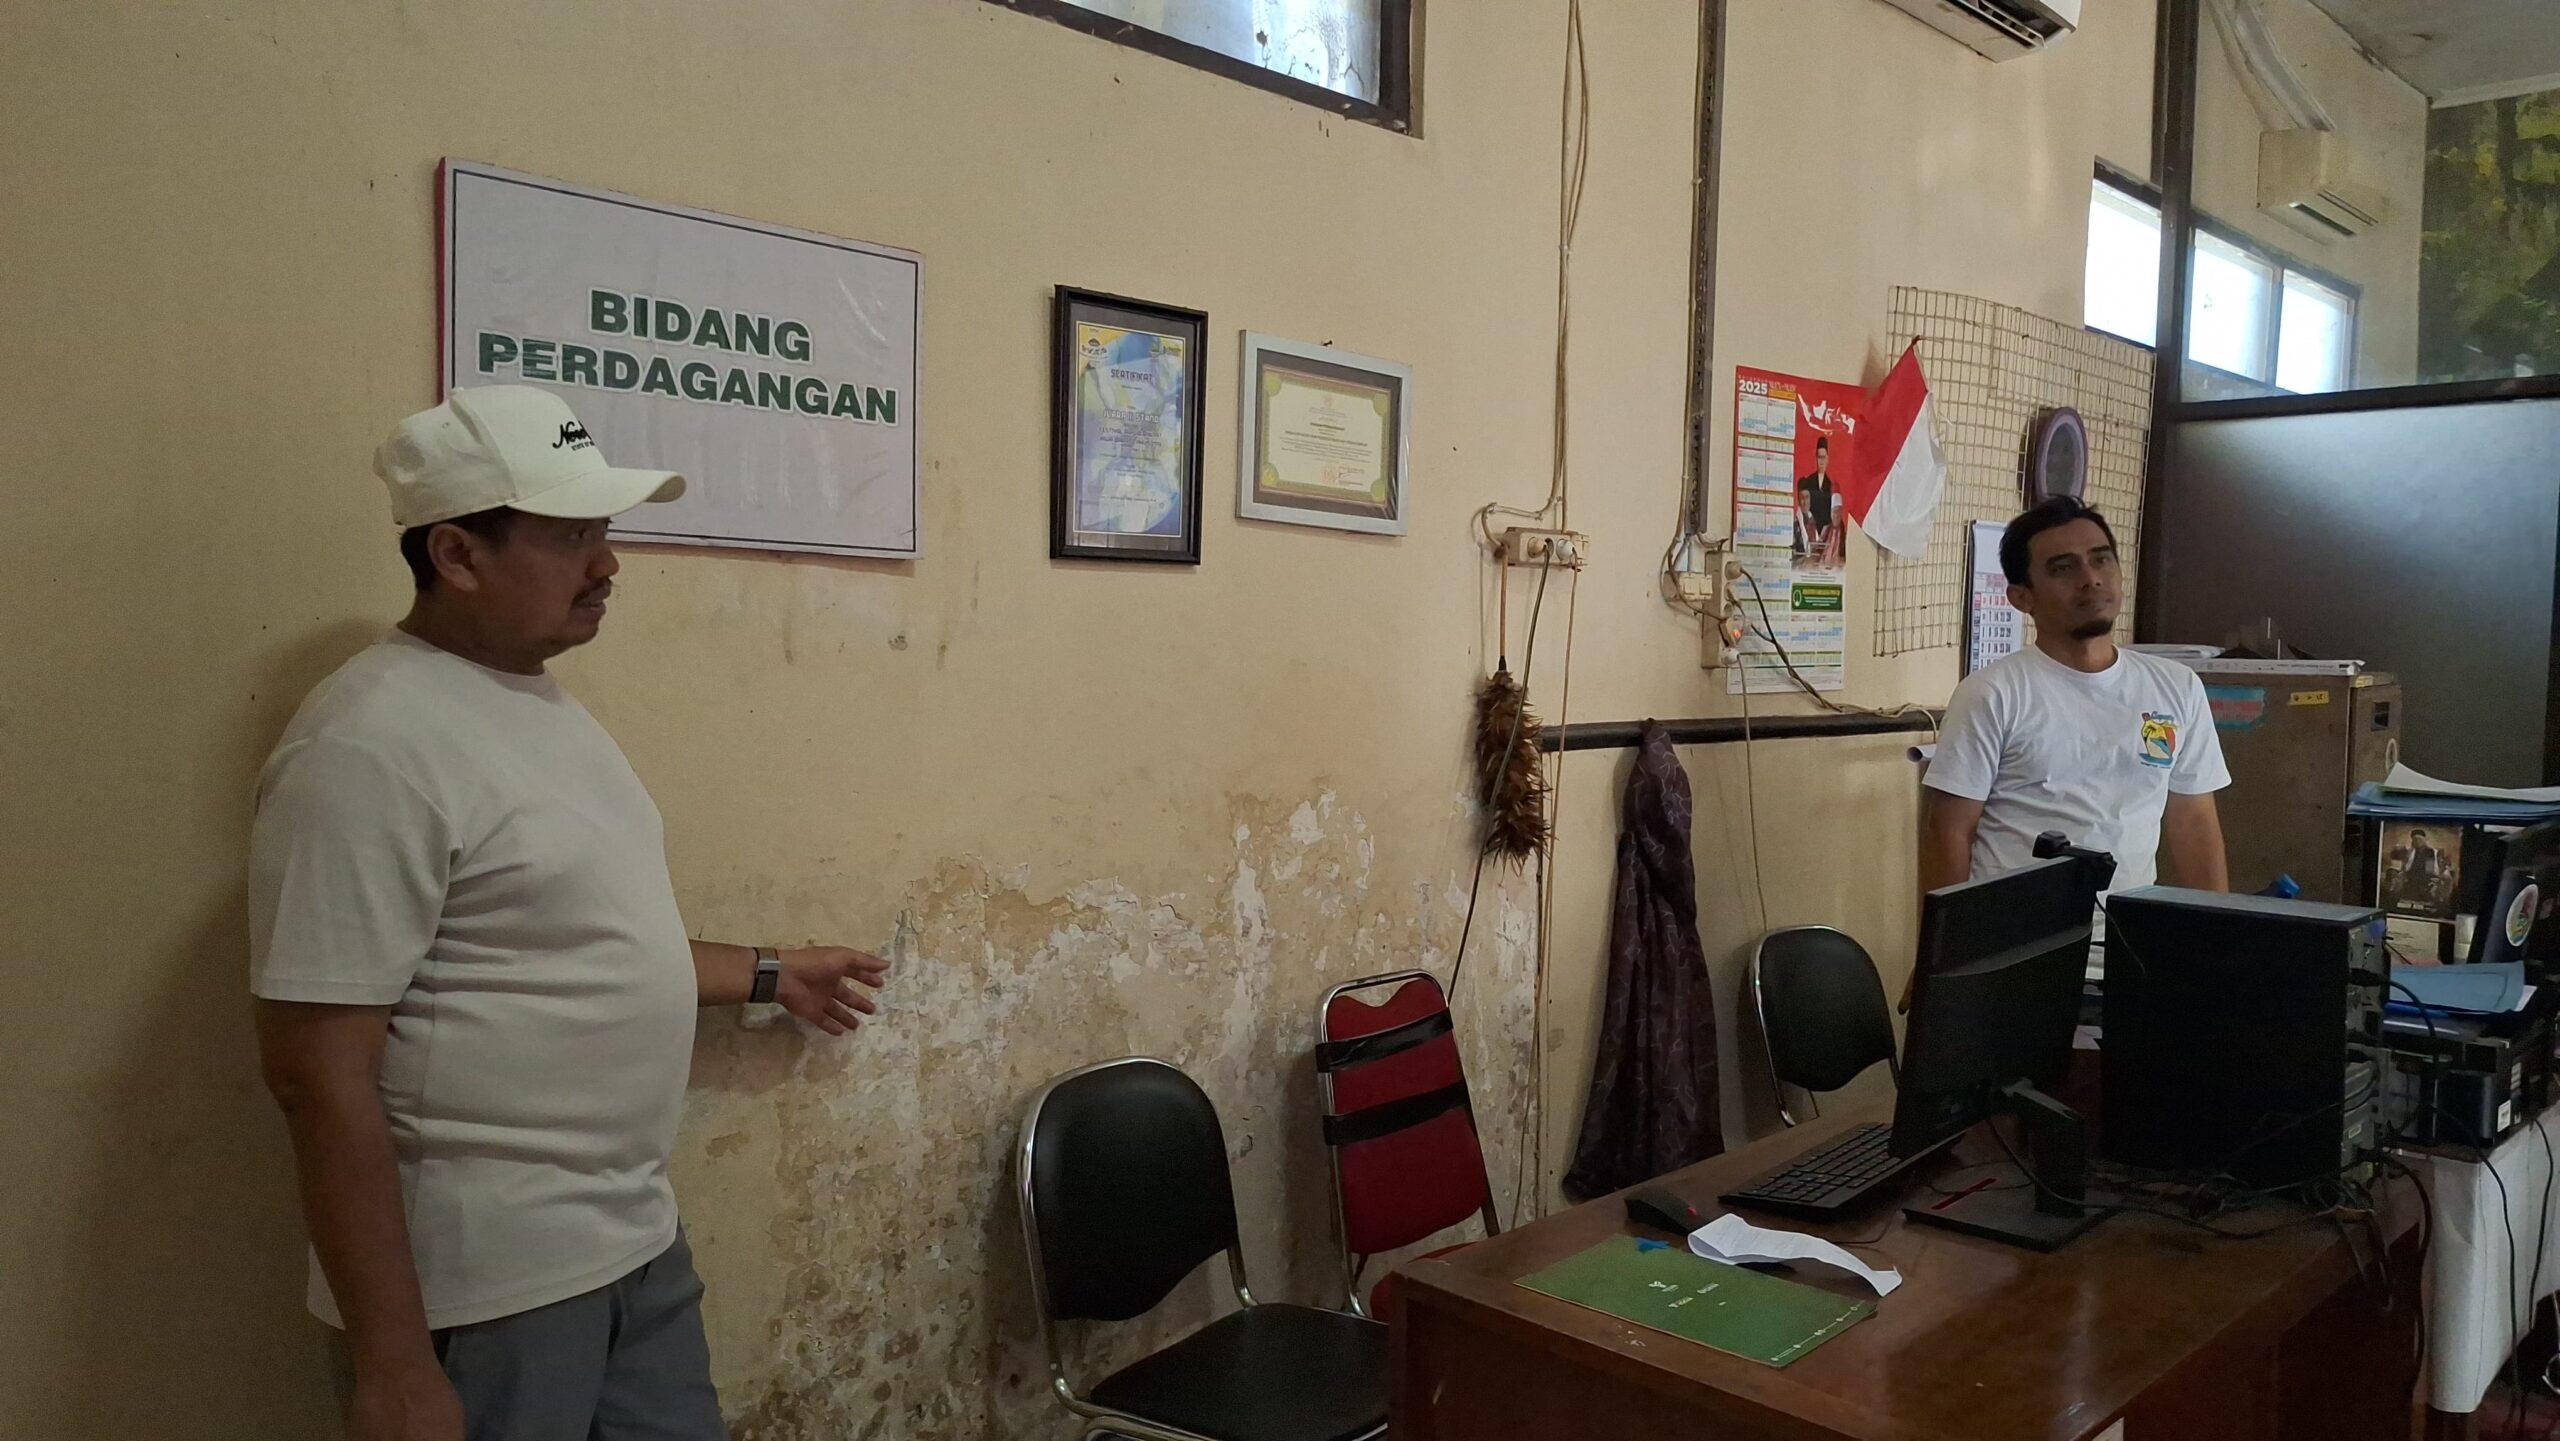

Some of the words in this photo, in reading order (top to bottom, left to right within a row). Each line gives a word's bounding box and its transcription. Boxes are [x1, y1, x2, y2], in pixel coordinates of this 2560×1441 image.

[592, 291, 811, 361] BIDANG
[478, 333, 898, 424] PERDAGANGAN
[1111, 369, 1153, 382] SERTIFIKAT
[1739, 379, 1768, 395] 2025
